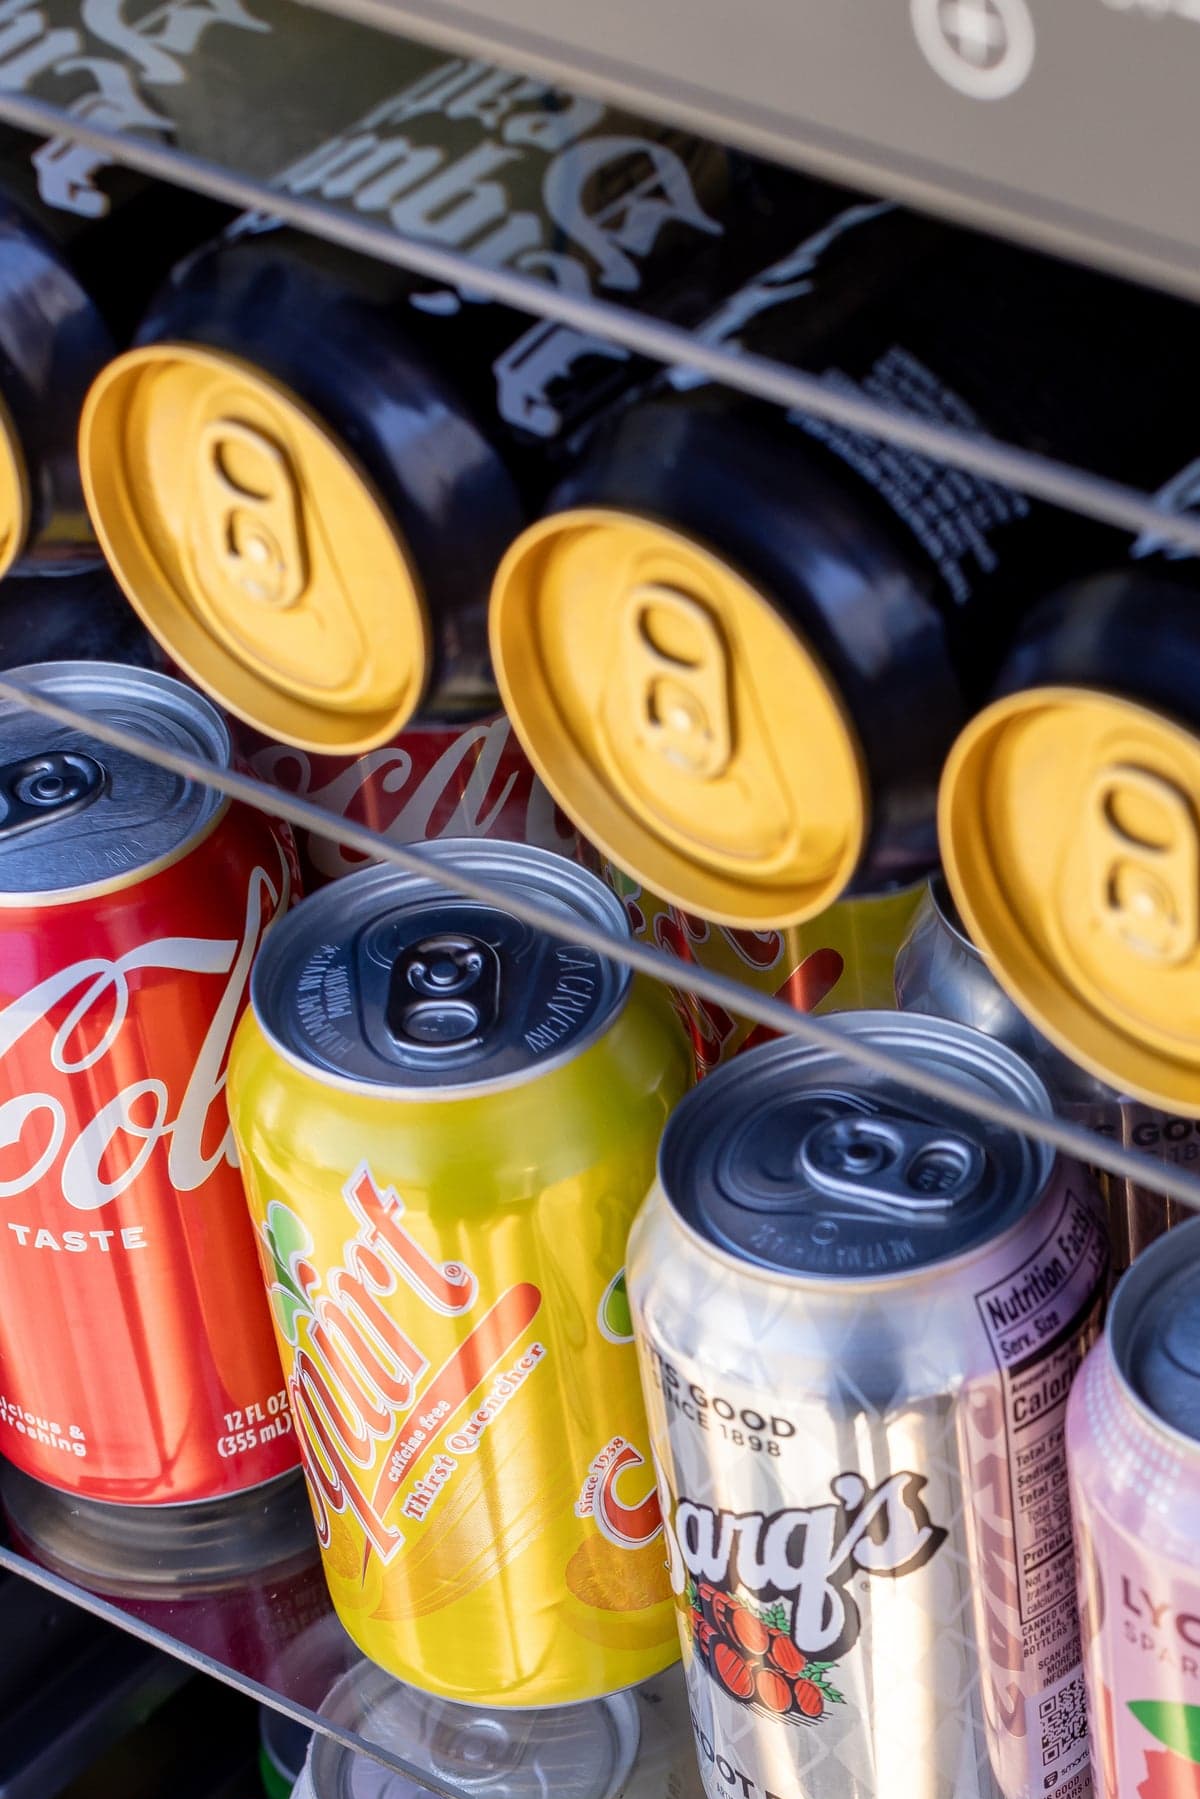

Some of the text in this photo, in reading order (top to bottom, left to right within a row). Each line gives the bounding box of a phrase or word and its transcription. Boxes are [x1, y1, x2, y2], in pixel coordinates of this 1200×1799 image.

[0, 868, 288, 1210] Col
[7, 1223, 148, 1252] TASTE
[986, 1257, 1067, 1330] Nutrition
[1057, 1208, 1092, 1267] Facts
[1001, 1310, 1061, 1360] Serv. Size
[291, 1162, 478, 1564] quirt
[0, 1397, 86, 1441] icious &
[224, 1389, 288, 1432] 12 FL OZ
[689, 1383, 796, 1438] GOOD
[0, 1408, 87, 1457] freshing
[217, 1416, 293, 1458] (355 mL)
[388, 1400, 451, 1483] caffeine free
[403, 1344, 546, 1521] Thirst Quencher
[720, 1423, 782, 1458] 1898
[579, 1437, 625, 1515] Since 1938
[1016, 1443, 1047, 1469] Total
[1017, 1454, 1061, 1488] Sodium
[652, 1458, 948, 1658] arq's
[1022, 1529, 1066, 1567] Protein
[1022, 1608, 1058, 1637] CANNED
[1038, 1650, 1059, 1671] SCAN
[1046, 1655, 1067, 1675] MORE
[1055, 1775, 1080, 1799] GOOD
